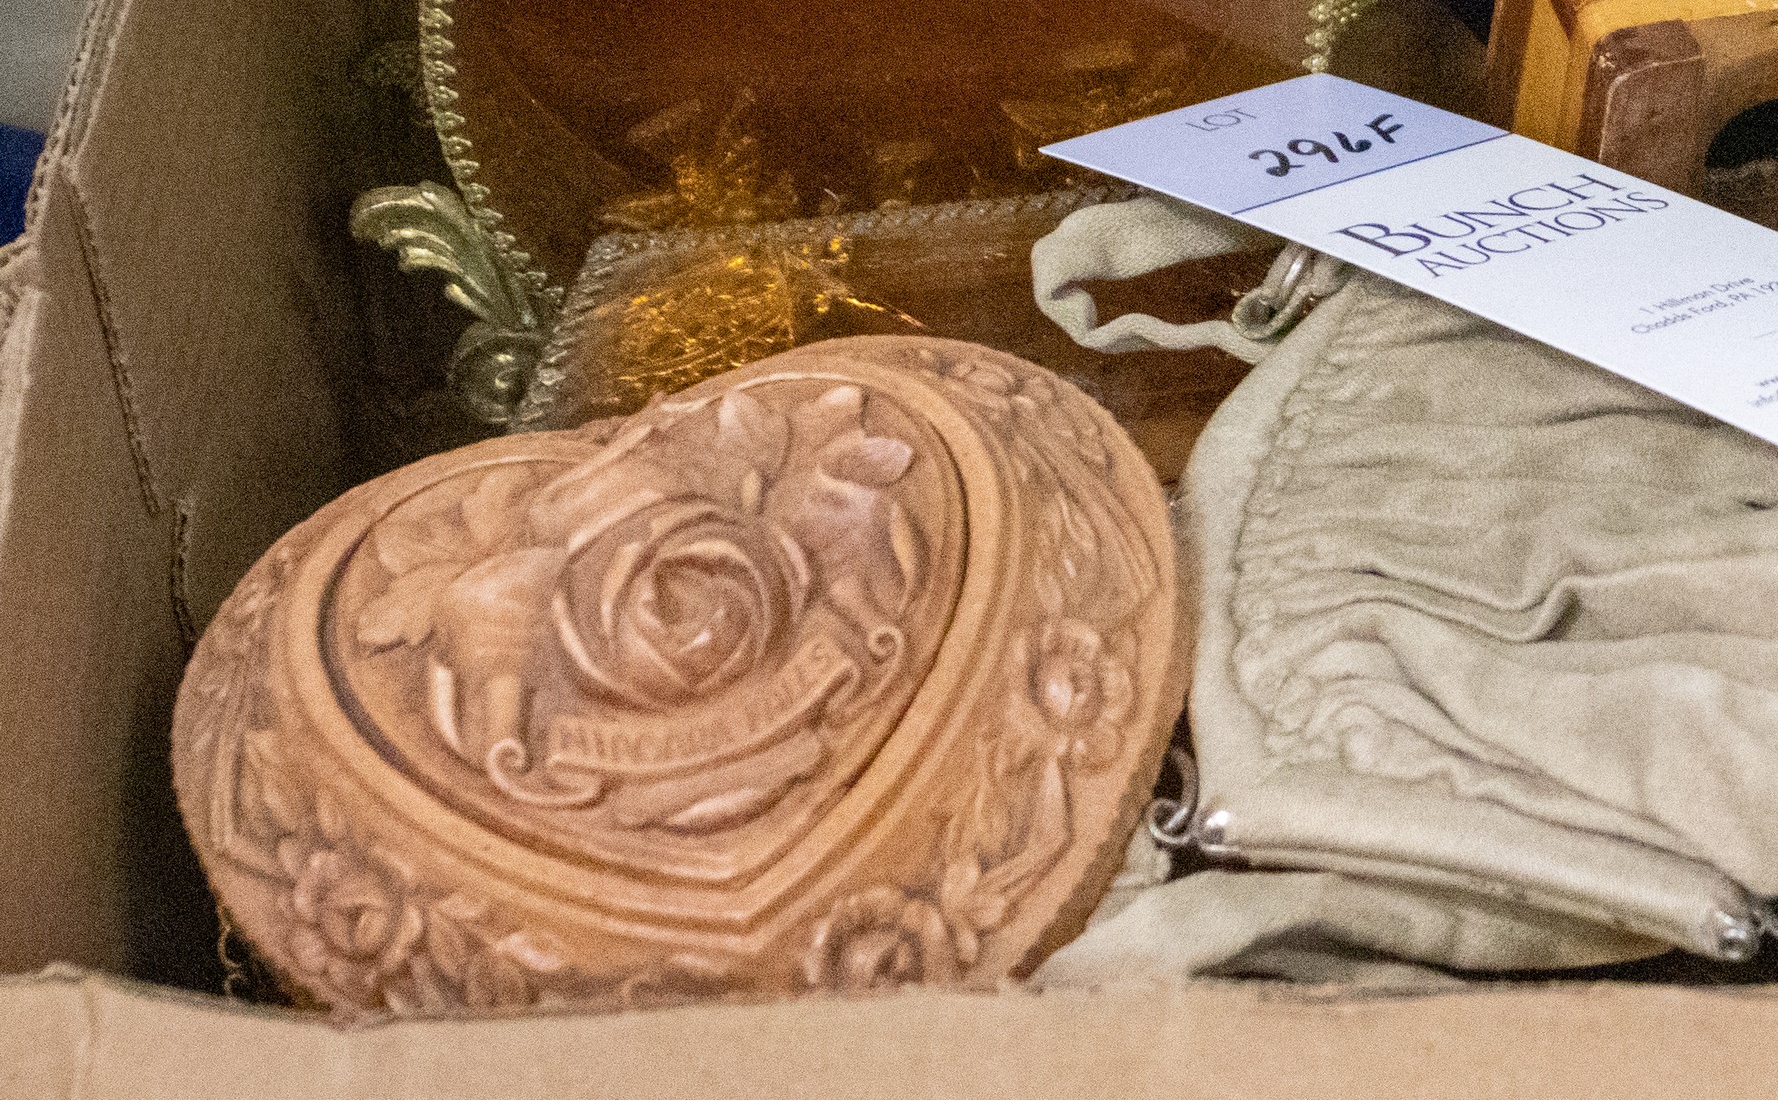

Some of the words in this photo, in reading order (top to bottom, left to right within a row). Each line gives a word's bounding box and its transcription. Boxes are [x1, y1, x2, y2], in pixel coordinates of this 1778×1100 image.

[1184, 107, 1257, 132] LOT
[1247, 113, 1405, 178] 296F
[1328, 173, 1624, 257] BUNCH
[1415, 191, 1669, 278] AUCTIONS
[1630, 313, 1693, 334] Chadds
[1687, 299, 1736, 316] Ford,
[1727, 291, 1757, 302] PA
[1651, 289, 1716, 311] Hillman
[1710, 277, 1755, 293] Drive
